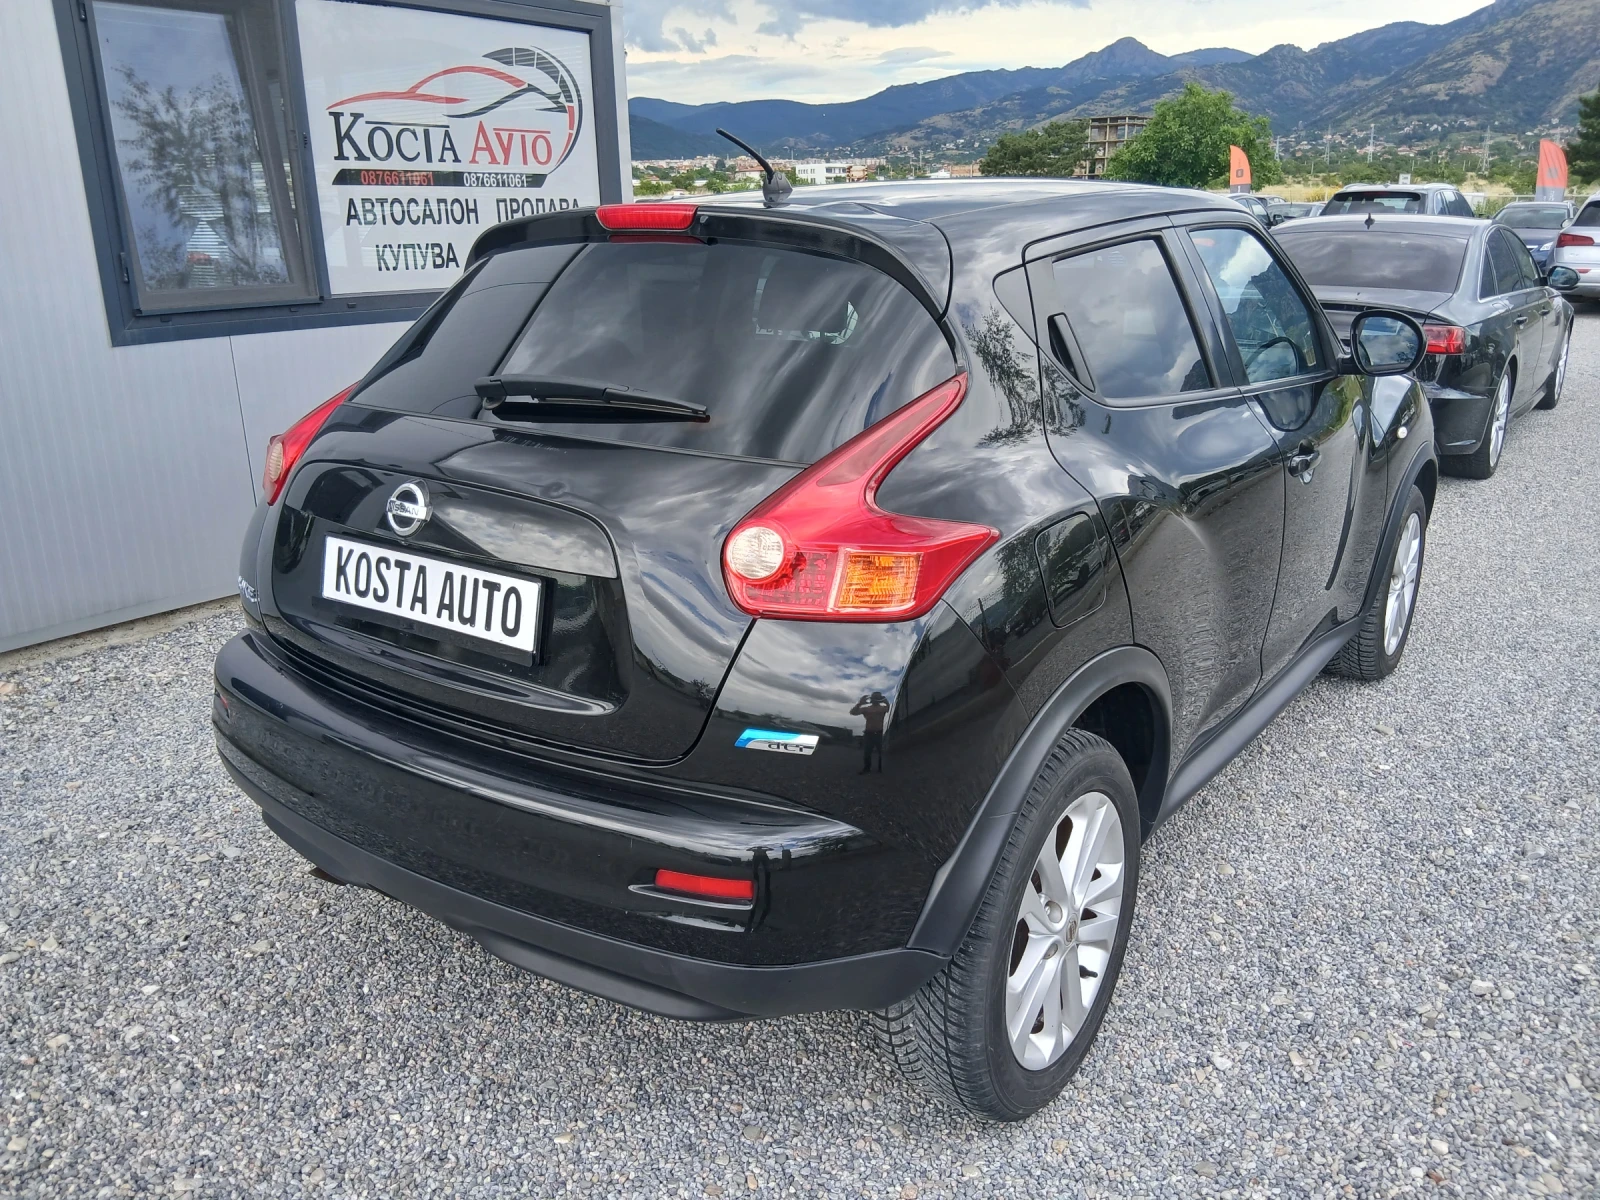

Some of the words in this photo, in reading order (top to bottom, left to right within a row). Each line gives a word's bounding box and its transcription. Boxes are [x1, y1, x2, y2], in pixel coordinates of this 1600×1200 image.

[360, 170, 434, 186] 0876611061
[463, 172, 528, 188] 0876611061
[346, 197, 479, 226] АВТОСАЛОН
[375, 242, 460, 271] КУПУВА
[388, 499, 420, 516] NISSAN
[335, 546, 427, 615] KOSTA
[436, 571, 522, 638] AUTO
